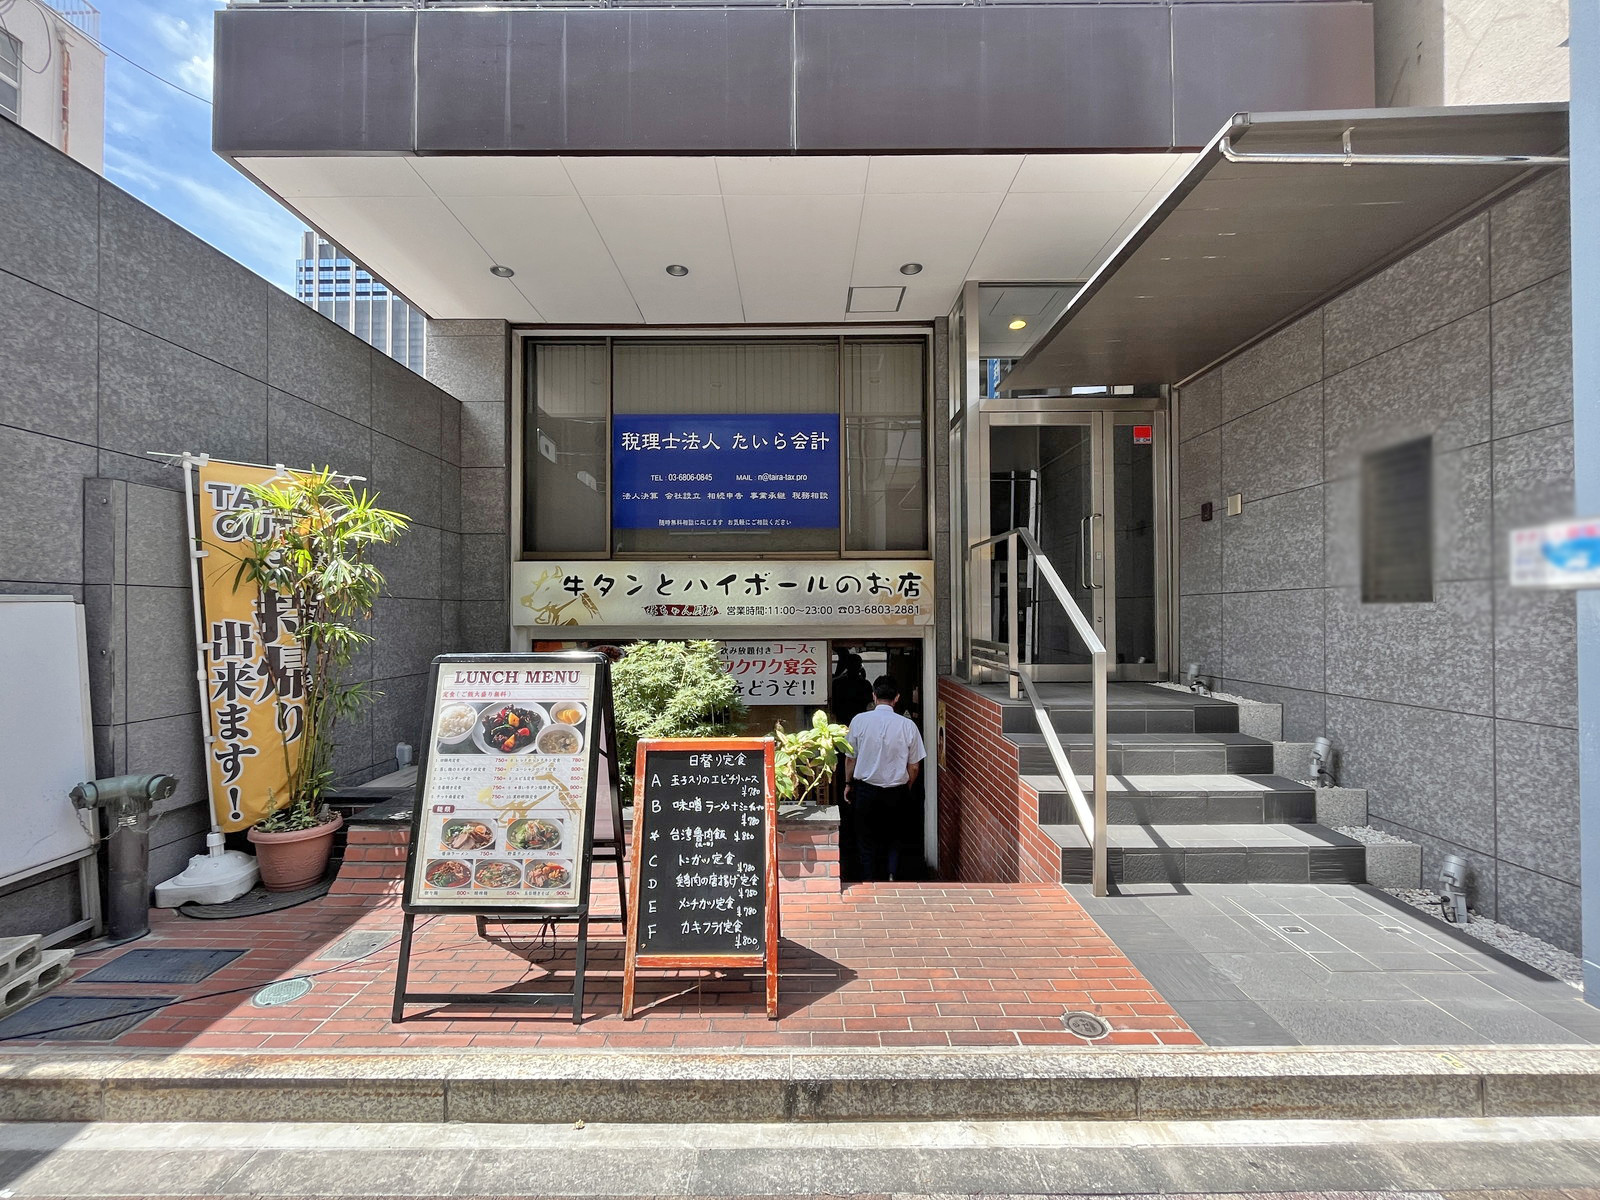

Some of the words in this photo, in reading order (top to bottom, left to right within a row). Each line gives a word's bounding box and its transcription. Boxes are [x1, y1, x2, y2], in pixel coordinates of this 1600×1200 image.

[621, 431, 721, 451] 税理士法人
[731, 431, 831, 451] たいら会計
[650, 474, 663, 482] TEL
[668, 473, 713, 482] 03-6806-0845
[736, 474, 753, 482] MAIL
[622, 492, 659, 500] 法人決算
[664, 492, 702, 500] 会社設立
[707, 492, 744, 500] 相続申告
[791, 492, 829, 500] 税務相談
[563, 571, 923, 598] 牛タンとハイボールのお店
[454, 670, 519, 684] LUNCH
[525, 670, 581, 684] MENU
[689, 752, 748, 769] 日替り定食
[651, 773, 662, 787] A
[651, 799, 662, 814] B
[648, 854, 658, 867] C
[647, 879, 658, 890] D
[648, 900, 658, 913] E
[647, 924, 657, 940] F
[680, 920, 744, 936] カキフライ定食
